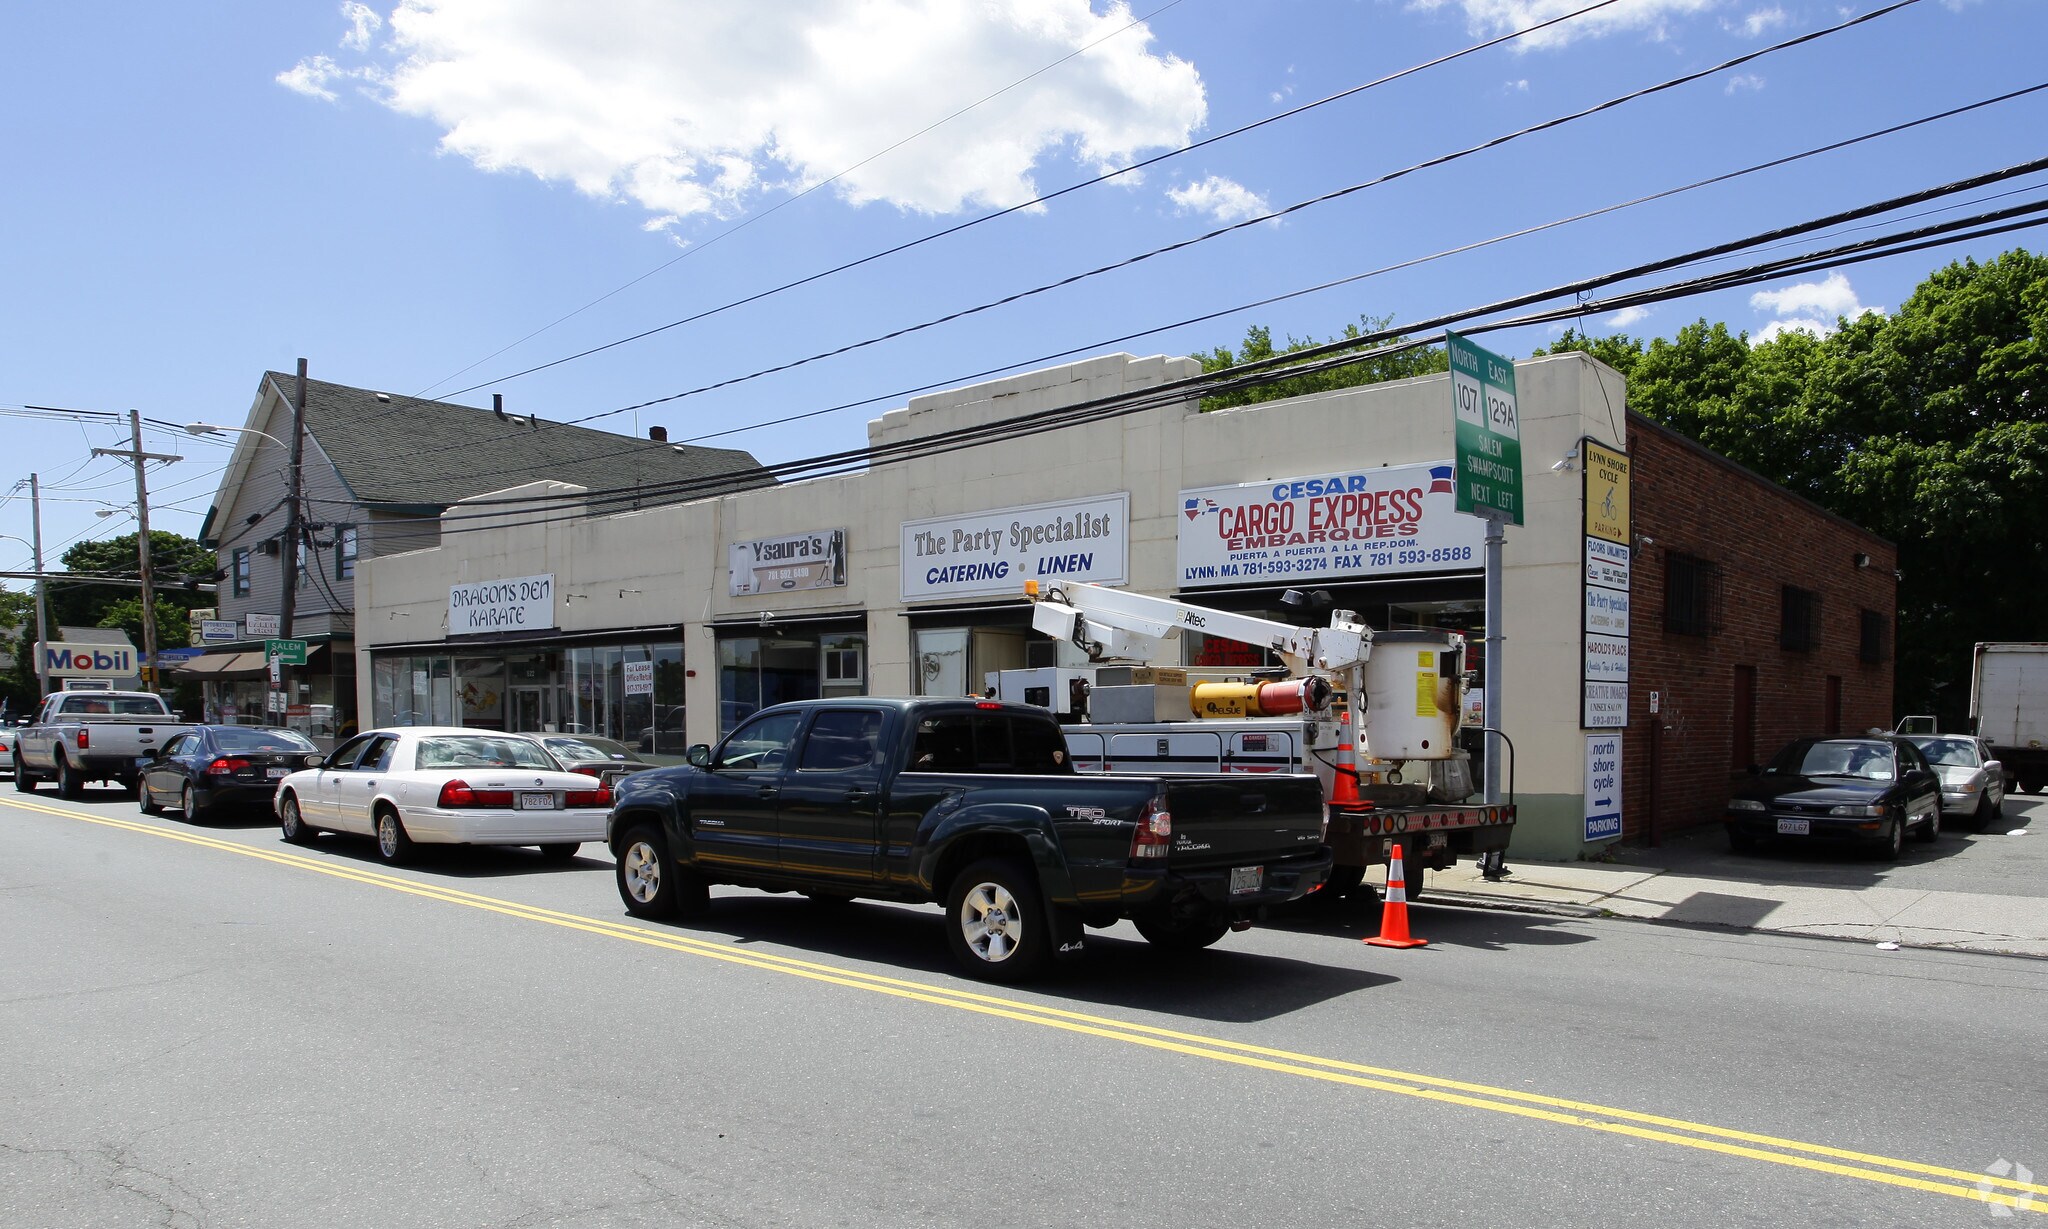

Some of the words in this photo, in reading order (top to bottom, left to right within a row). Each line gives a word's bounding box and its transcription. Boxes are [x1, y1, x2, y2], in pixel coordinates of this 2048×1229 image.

[1451, 342, 1478, 373] NORTH
[1488, 360, 1507, 385] EAST
[1457, 382, 1477, 413] 107
[1487, 396, 1516, 430] 129A
[1478, 435, 1502, 458] SALEM
[1467, 454, 1514, 485] SWAMPSCOTT
[1589, 450, 1606, 466] LYNN
[1607, 457, 1627, 474] SHORE
[1599, 468, 1618, 484] CYCLE
[1272, 475, 1367, 501] CESAR
[1471, 482, 1490, 503] NEXT
[1497, 490, 1513, 510] LEFT
[1218, 501, 1294, 540] CARGO
[1308, 487, 1424, 531] EXPRESS
[914, 530, 946, 557] The
[952, 527, 1003, 555] Party
[1010, 512, 1110, 553] Specialist
[1227, 522, 1420, 551] EMBARQUES
[1594, 522, 1617, 537] PARKING
[752, 535, 822, 562] Ysaura's
[1230, 551, 1268, 561] PUERTA
[1273, 550, 1280, 558] A
[1285, 546, 1326, 556] PUERTA
[1344, 543, 1358, 551] LA
[1364, 539, 1419, 550] REP.DOM.
[1588, 540, 1605, 554] FLOORS
[926, 560, 1010, 585] CATERING
[1037, 552, 1094, 575] LINEN
[1185, 565, 1218, 580] LYNN,
[1221, 564, 1239, 577] MA
[1242, 557, 1328, 575] 781-593-3274
[1334, 554, 1363, 569] FAX
[1370, 552, 1393, 566] 781
[1398, 546, 1472, 564] 593-8588
[452, 583, 517, 608] DRAGON'S
[520, 579, 550, 601] DEN
[1587, 591, 1596, 606] The
[1596, 593, 1608, 612] Party
[469, 605, 525, 627] KARATE
[1184, 611, 1206, 628] Altec
[271, 642, 301, 650] SALEM
[1611, 644, 1627, 656] PLACE
[47, 649, 129, 670] Mobil
[1585, 685, 1609, 699] CREATIVE
[1609, 686, 1627, 700] IMAGES
[1213, 705, 1241, 714] PELSUE
[1593, 740, 1615, 755] north
[1593, 758, 1615, 772] shore
[1593, 774, 1614, 792] cycle
[1066, 807, 1105, 820] TRD
[1588, 818, 1618, 834] PARKING
[1060, 940, 1084, 951] 4x4
